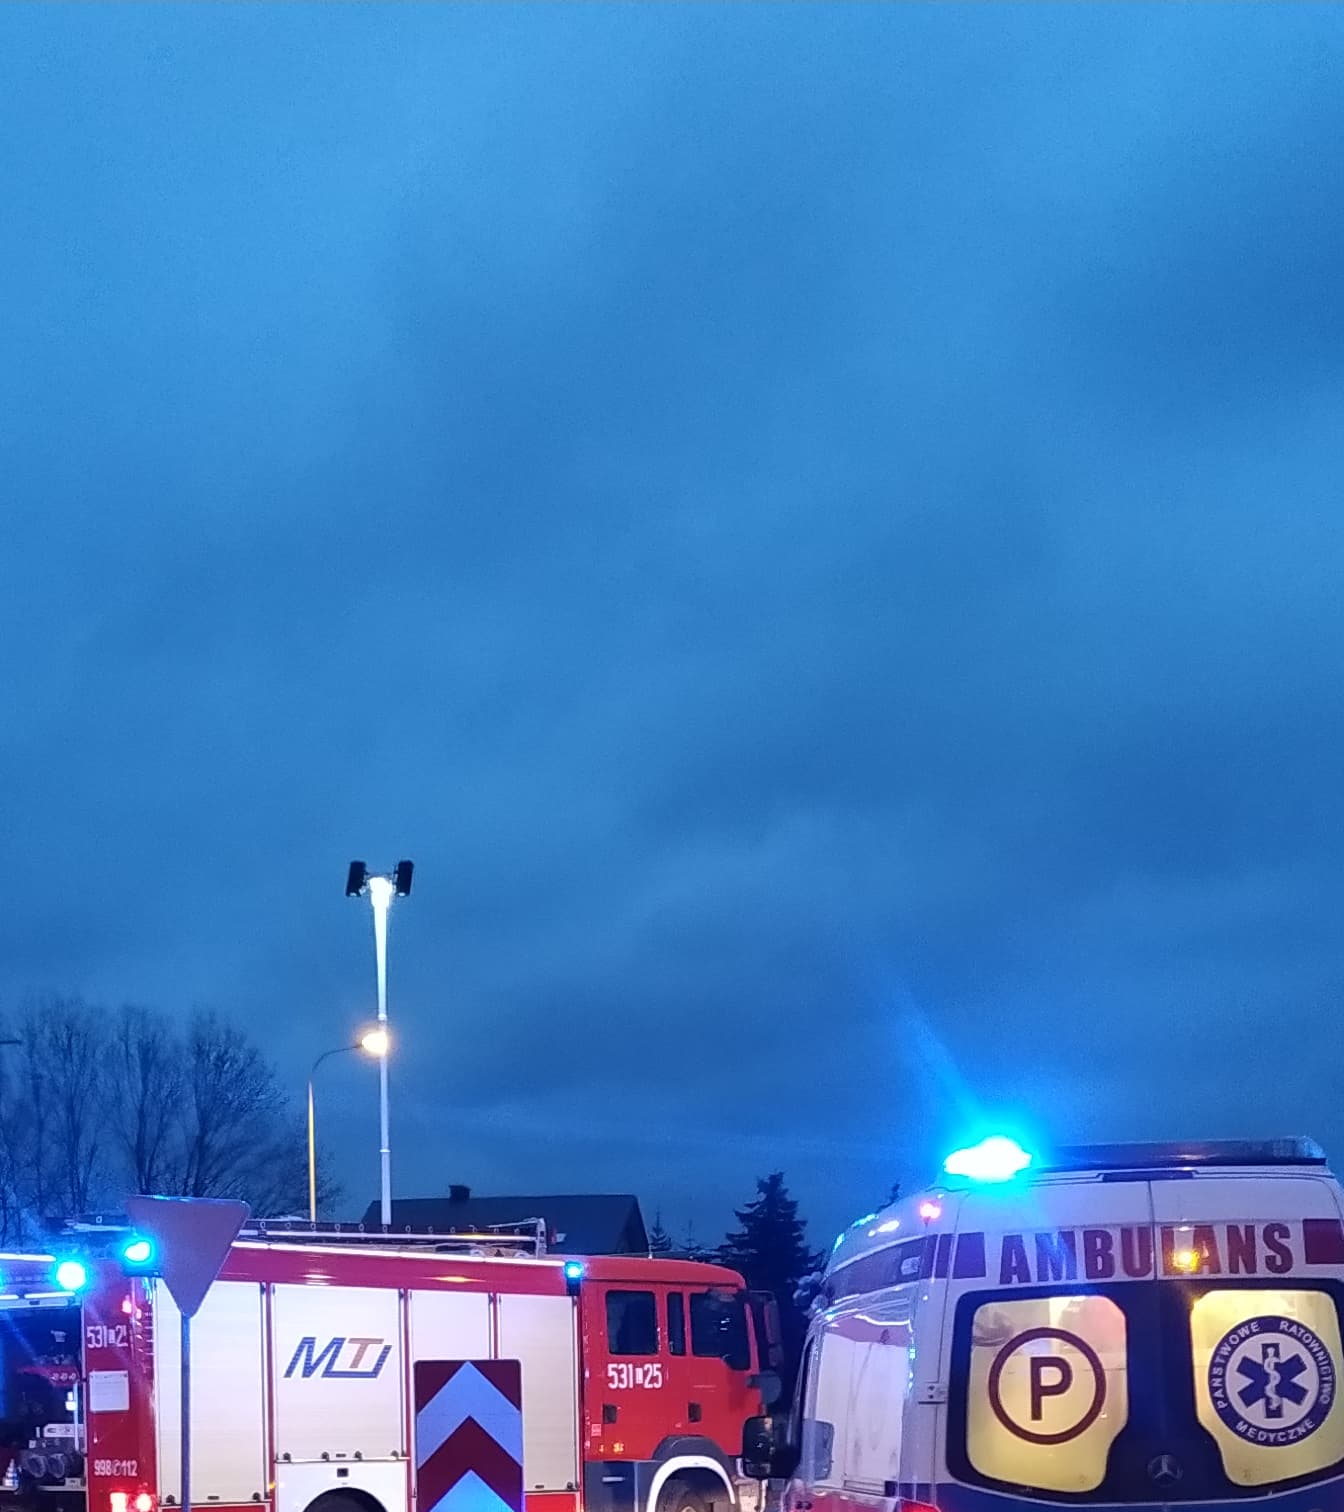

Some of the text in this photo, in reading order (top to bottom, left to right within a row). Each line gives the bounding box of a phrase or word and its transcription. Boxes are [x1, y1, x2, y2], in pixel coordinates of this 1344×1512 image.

[999, 1223, 1294, 1285] AMBULANS
[1030, 1356, 1073, 1421] P
[1279, 1320, 1333, 1405] RATOWNICTWO
[1236, 1418, 1315, 1443] MEDYCZNE
